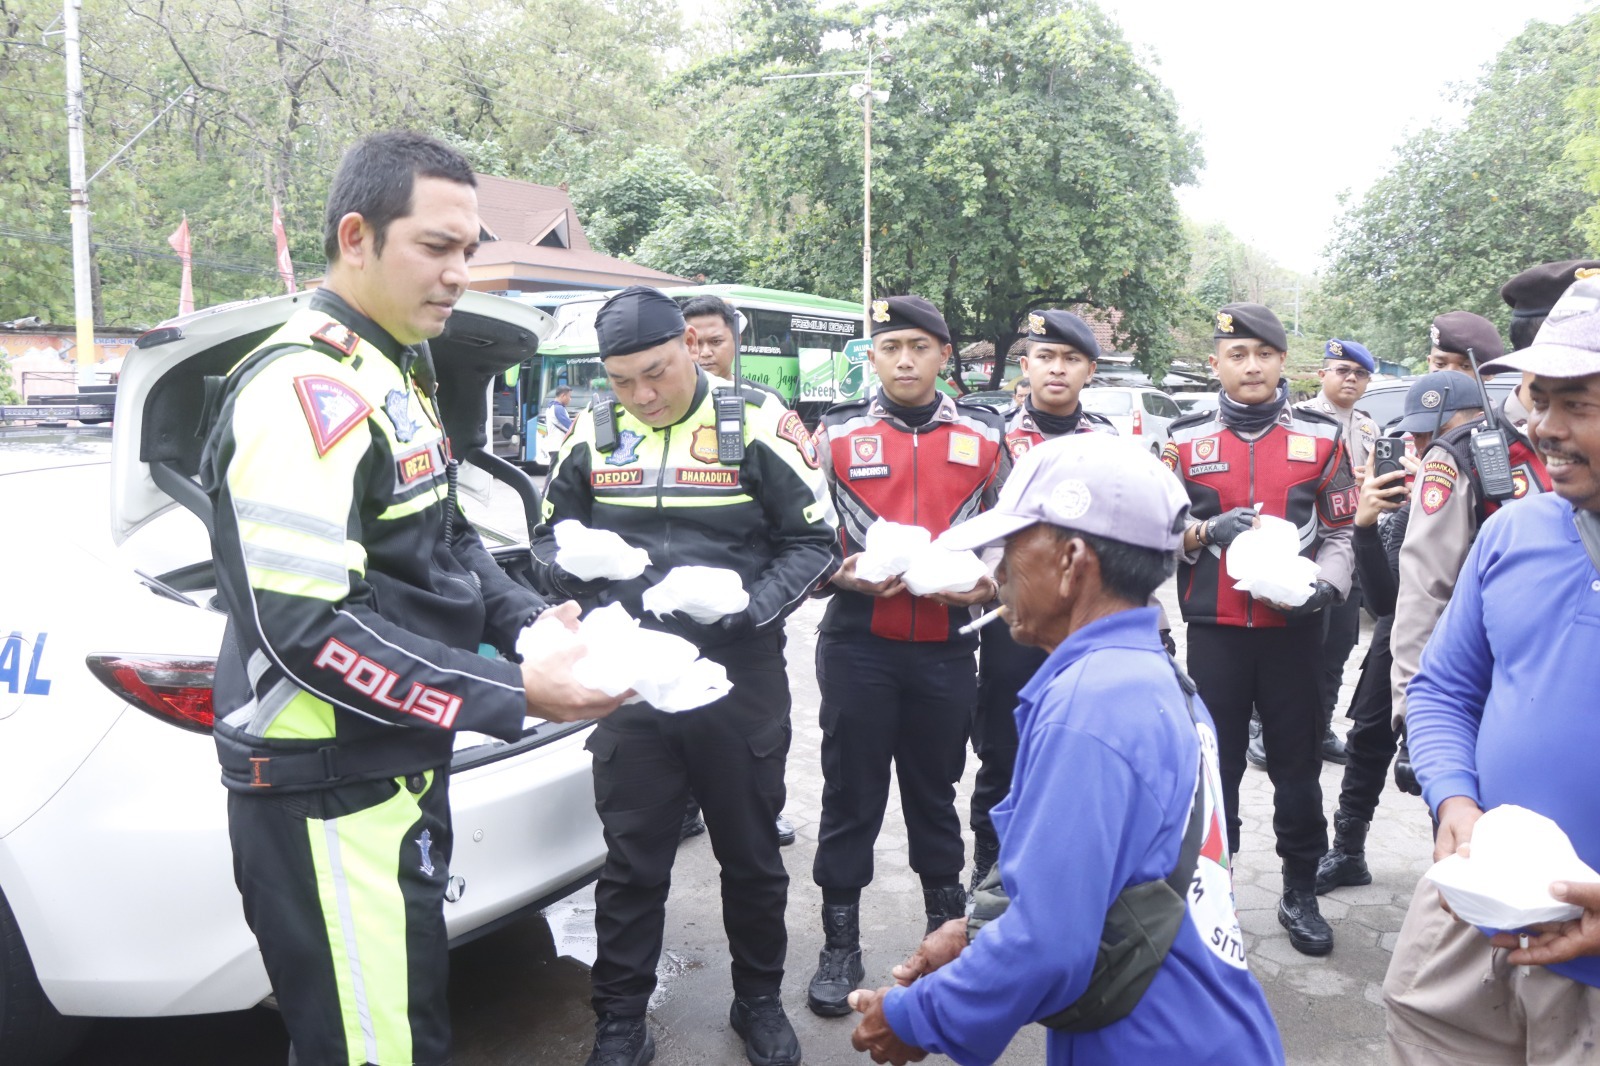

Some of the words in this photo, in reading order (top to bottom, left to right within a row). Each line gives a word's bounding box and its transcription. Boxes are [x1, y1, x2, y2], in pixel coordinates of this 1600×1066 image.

[790, 318, 828, 331] PREMIUM
[828, 322, 855, 334] COACH
[803, 381, 837, 399] Green
[404, 453, 431, 478] REZI
[596, 471, 638, 484] DEDDY
[681, 470, 732, 484] BHARADUTA
[0, 630, 51, 695] AL
[313, 637, 463, 729] POLISI
[1210, 926, 1246, 963] SITU
